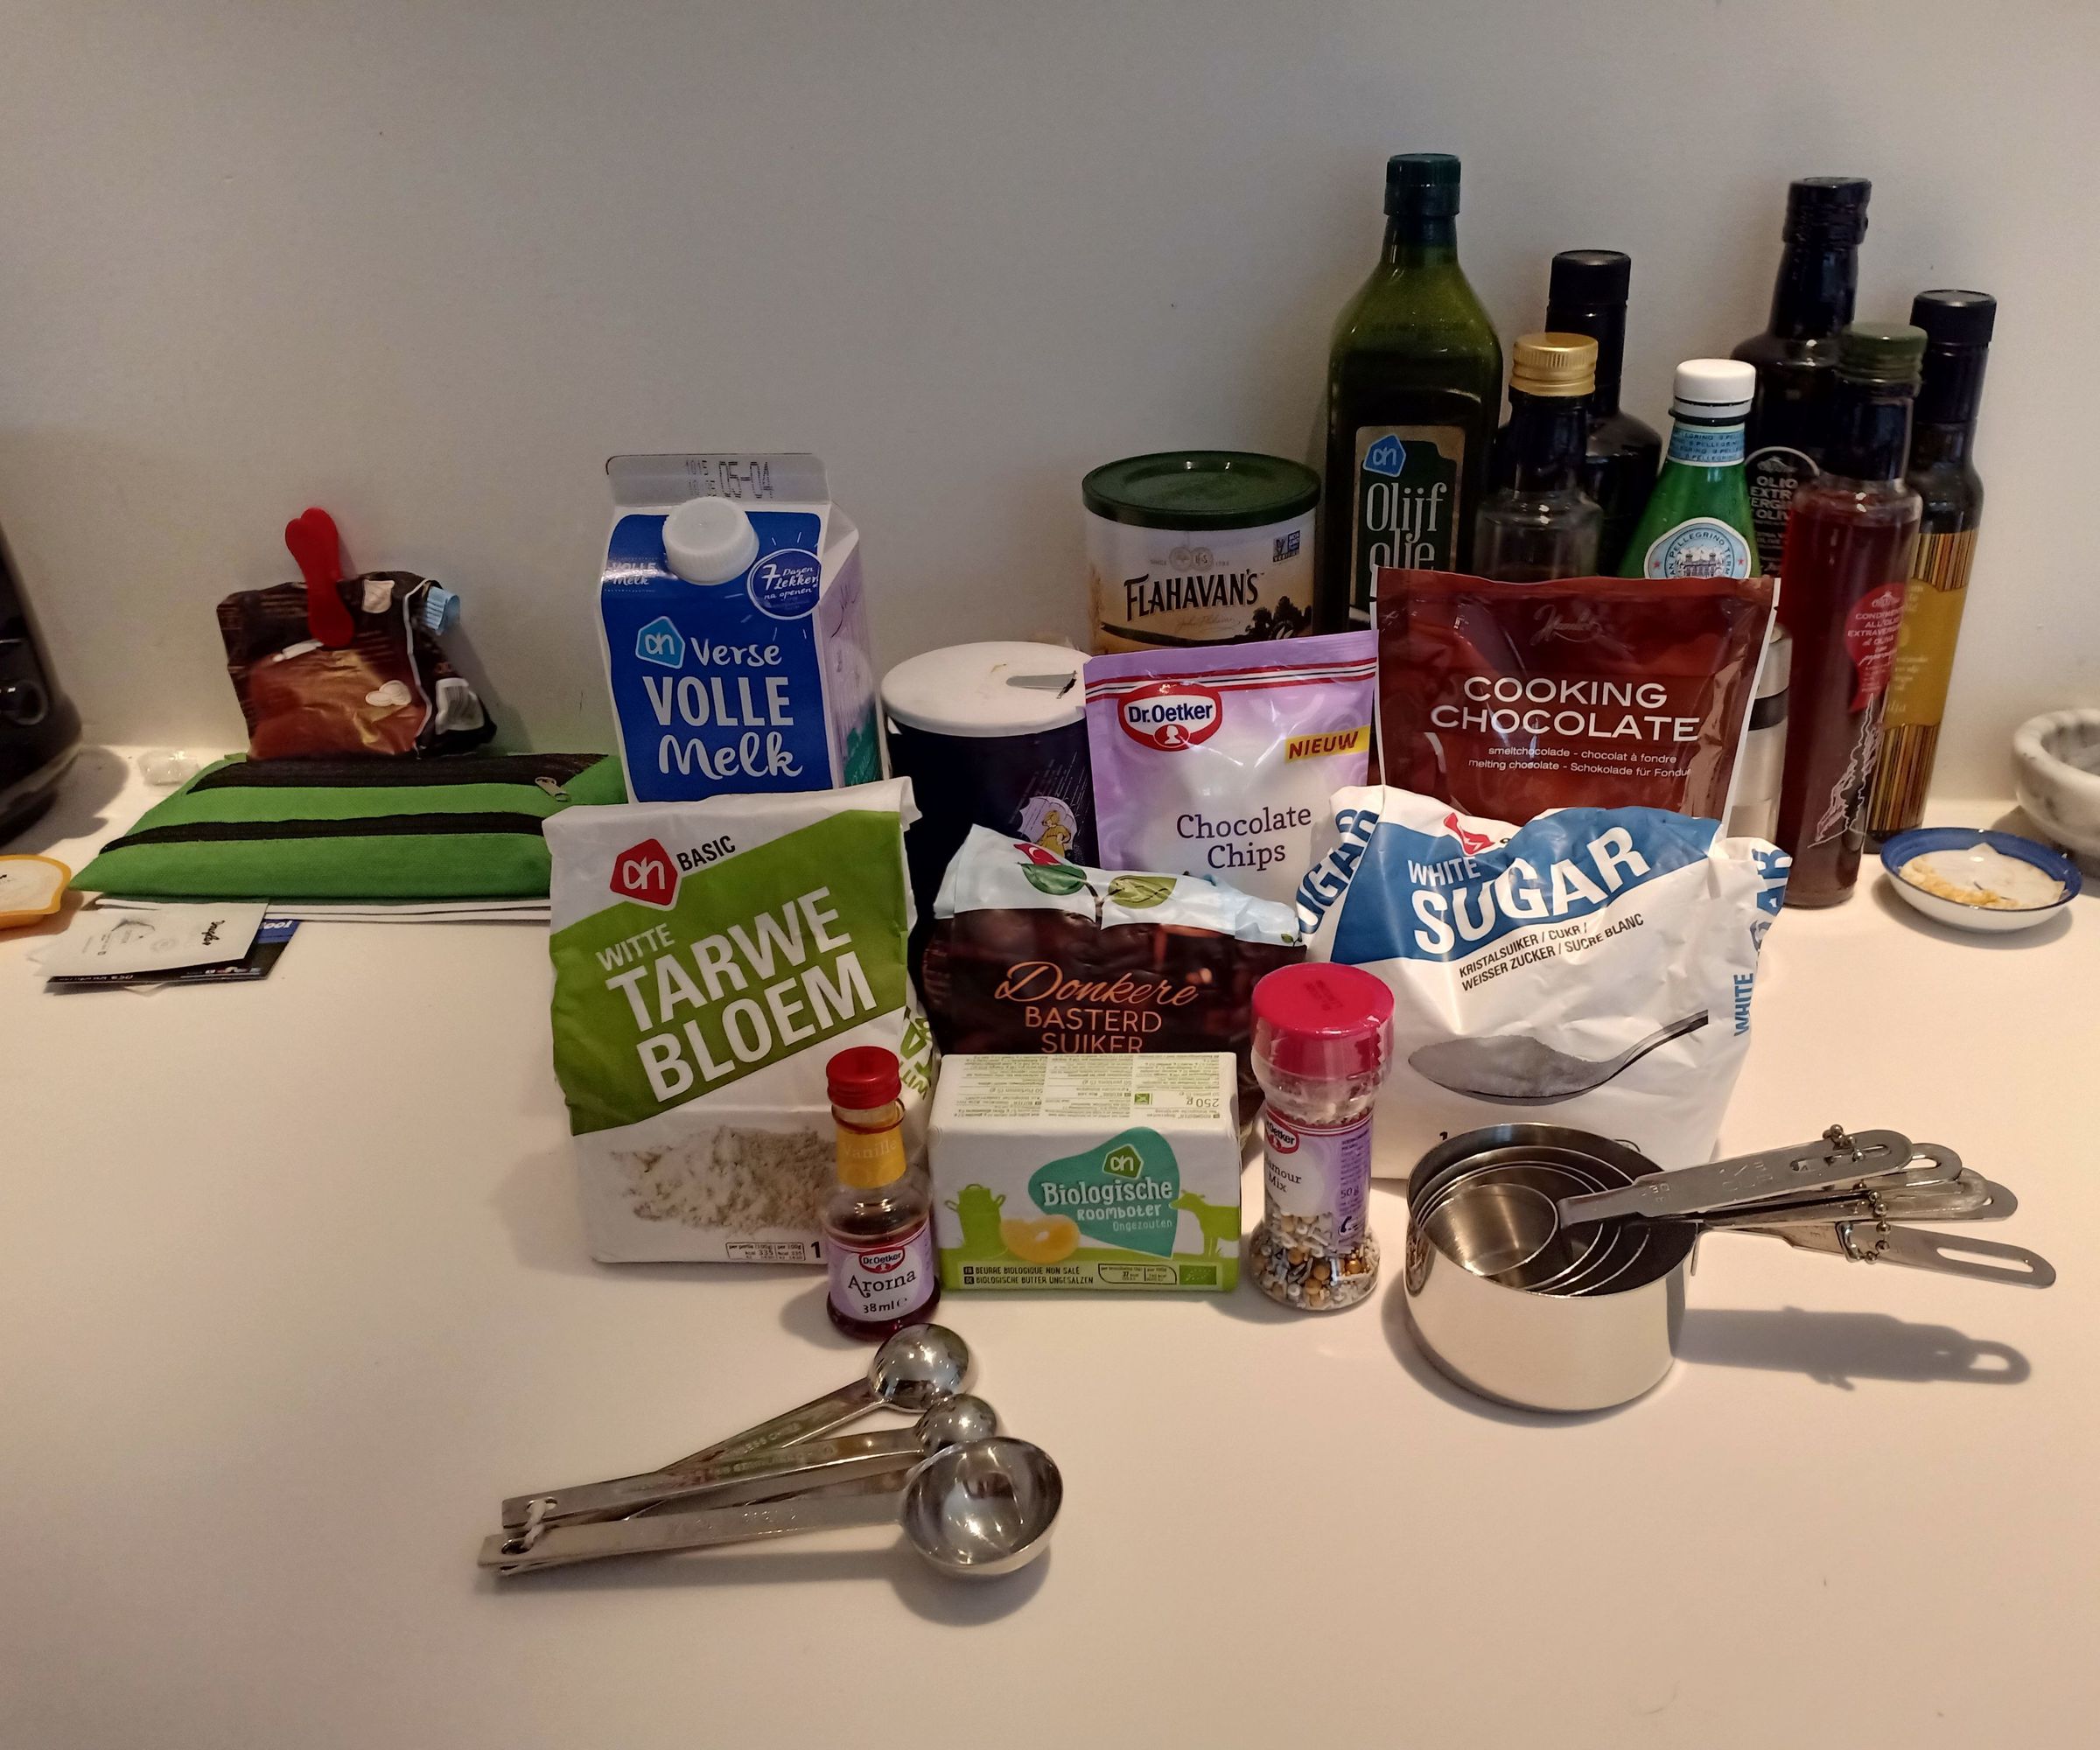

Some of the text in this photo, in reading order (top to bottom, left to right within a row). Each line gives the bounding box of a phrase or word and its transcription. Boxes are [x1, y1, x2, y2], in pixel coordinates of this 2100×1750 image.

[1750, 486, 1792, 500] EXTR
[1756, 475, 1798, 489] OLIO
[1366, 481, 1448, 544] Olijf
[1669, 531, 1726, 558] PELLEGRINO
[1724, 548, 1732, 575] TERM
[761, 564, 781, 591] 7
[1124, 569, 1259, 622] FLAHAVAN'S
[690, 637, 782, 667] Verse
[642, 676, 794, 727] VOLLE
[1464, 676, 1668, 709] COOKING
[1430, 705, 1701, 743] CHOCOLATE
[658, 732, 803, 780] Melk
[1287, 730, 1359, 760] NIEUW
[1488, 746, 1571, 758] smeltchocolade
[1581, 751, 1628, 761] chocolat
[1641, 754, 1677, 764] fondre
[1468, 759, 1507, 772] melting
[1508, 761, 1560, 771] chocolate
[1571, 762, 1634, 776] Schokolade
[1635, 766, 1648, 777] für
[1176, 807, 1312, 839] Chocolate
[676, 835, 737, 872] BASIC
[1207, 843, 1286, 872] Chips
[1296, 808, 1381, 935] UGAR
[1407, 856, 1481, 887] WHITE
[1411, 826, 1651, 955] SUGAR
[595, 922, 675, 971] WITTE
[606, 886, 852, 1032] TARWE
[1459, 934, 1539, 978] KRISTALSUIKER
[1548, 924, 1581, 941] CUKR
[1461, 962, 1508, 992] WEISSER
[1511, 946, 1556, 970] ZUCKER
[1565, 933, 1604, 953] SUCRE
[1605, 913, 1645, 939] BLANC
[994, 961, 1200, 1007] Donkere
[1024, 1006, 1163, 1034] BASTERD
[1730, 972, 1754, 1037] WHITE
[636, 950, 878, 1103] BLOEM
[1040, 1032, 1143, 1054] SUIKER
[1186, 1096, 1220, 1108] 250 g
[1040, 1177, 1173, 1206] Biologische
[1268, 1171, 1288, 1194] Mix
[1112, 1219, 1173, 1232] Ongezouten
[976, 1276, 1019, 1284] BIOLOGISCHE
[1004, 1266, 1044, 1275] BIOLOGIQUE
